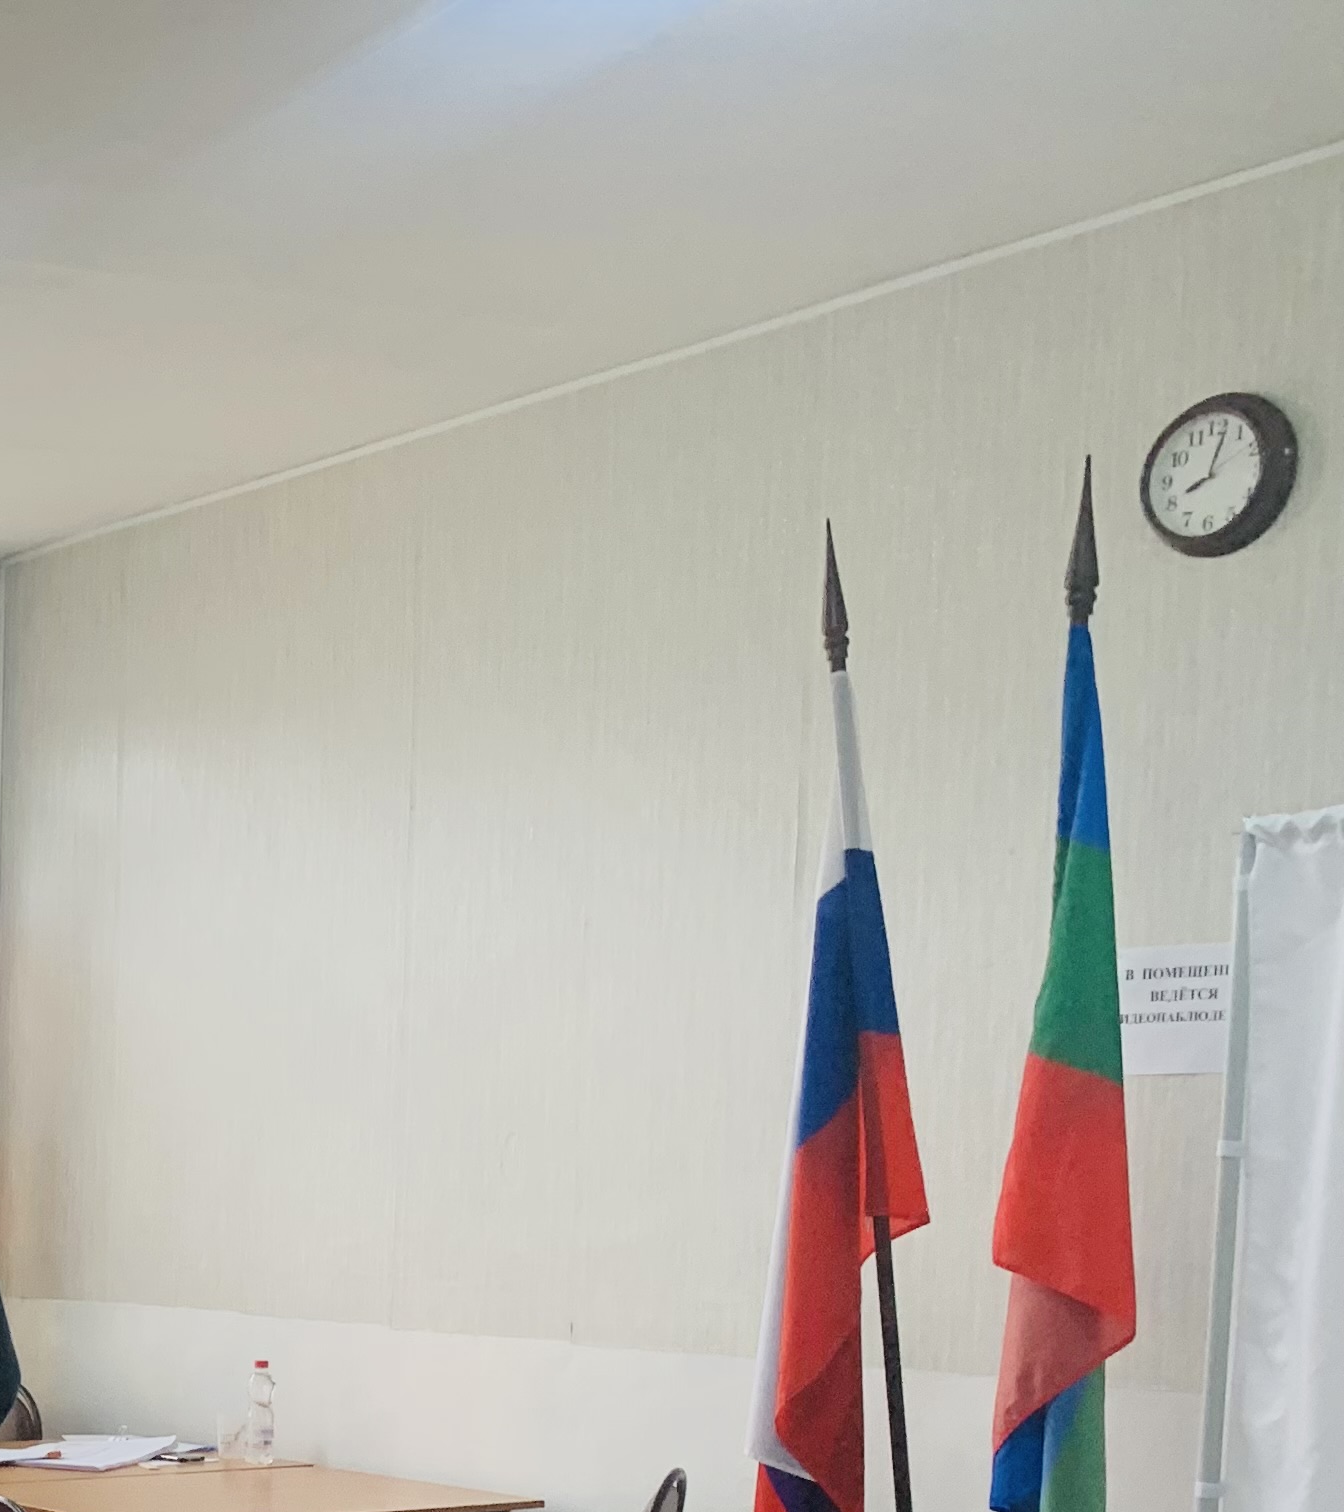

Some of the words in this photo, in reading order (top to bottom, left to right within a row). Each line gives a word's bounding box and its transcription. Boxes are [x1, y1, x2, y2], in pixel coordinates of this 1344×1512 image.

[1208, 419, 1228, 437] 12
[1235, 424, 1243, 440] 1
[1188, 430, 1204, 447] 11
[1171, 450, 1189, 468] 10
[1162, 475, 1173, 492] 9
[1166, 495, 1178, 512] 8
[1182, 511, 1193, 528] 7
[1202, 515, 1213, 531] 6
[1125, 969, 1135, 981] В
[1150, 986, 1218, 1002] ВЕДЁТСЯ
